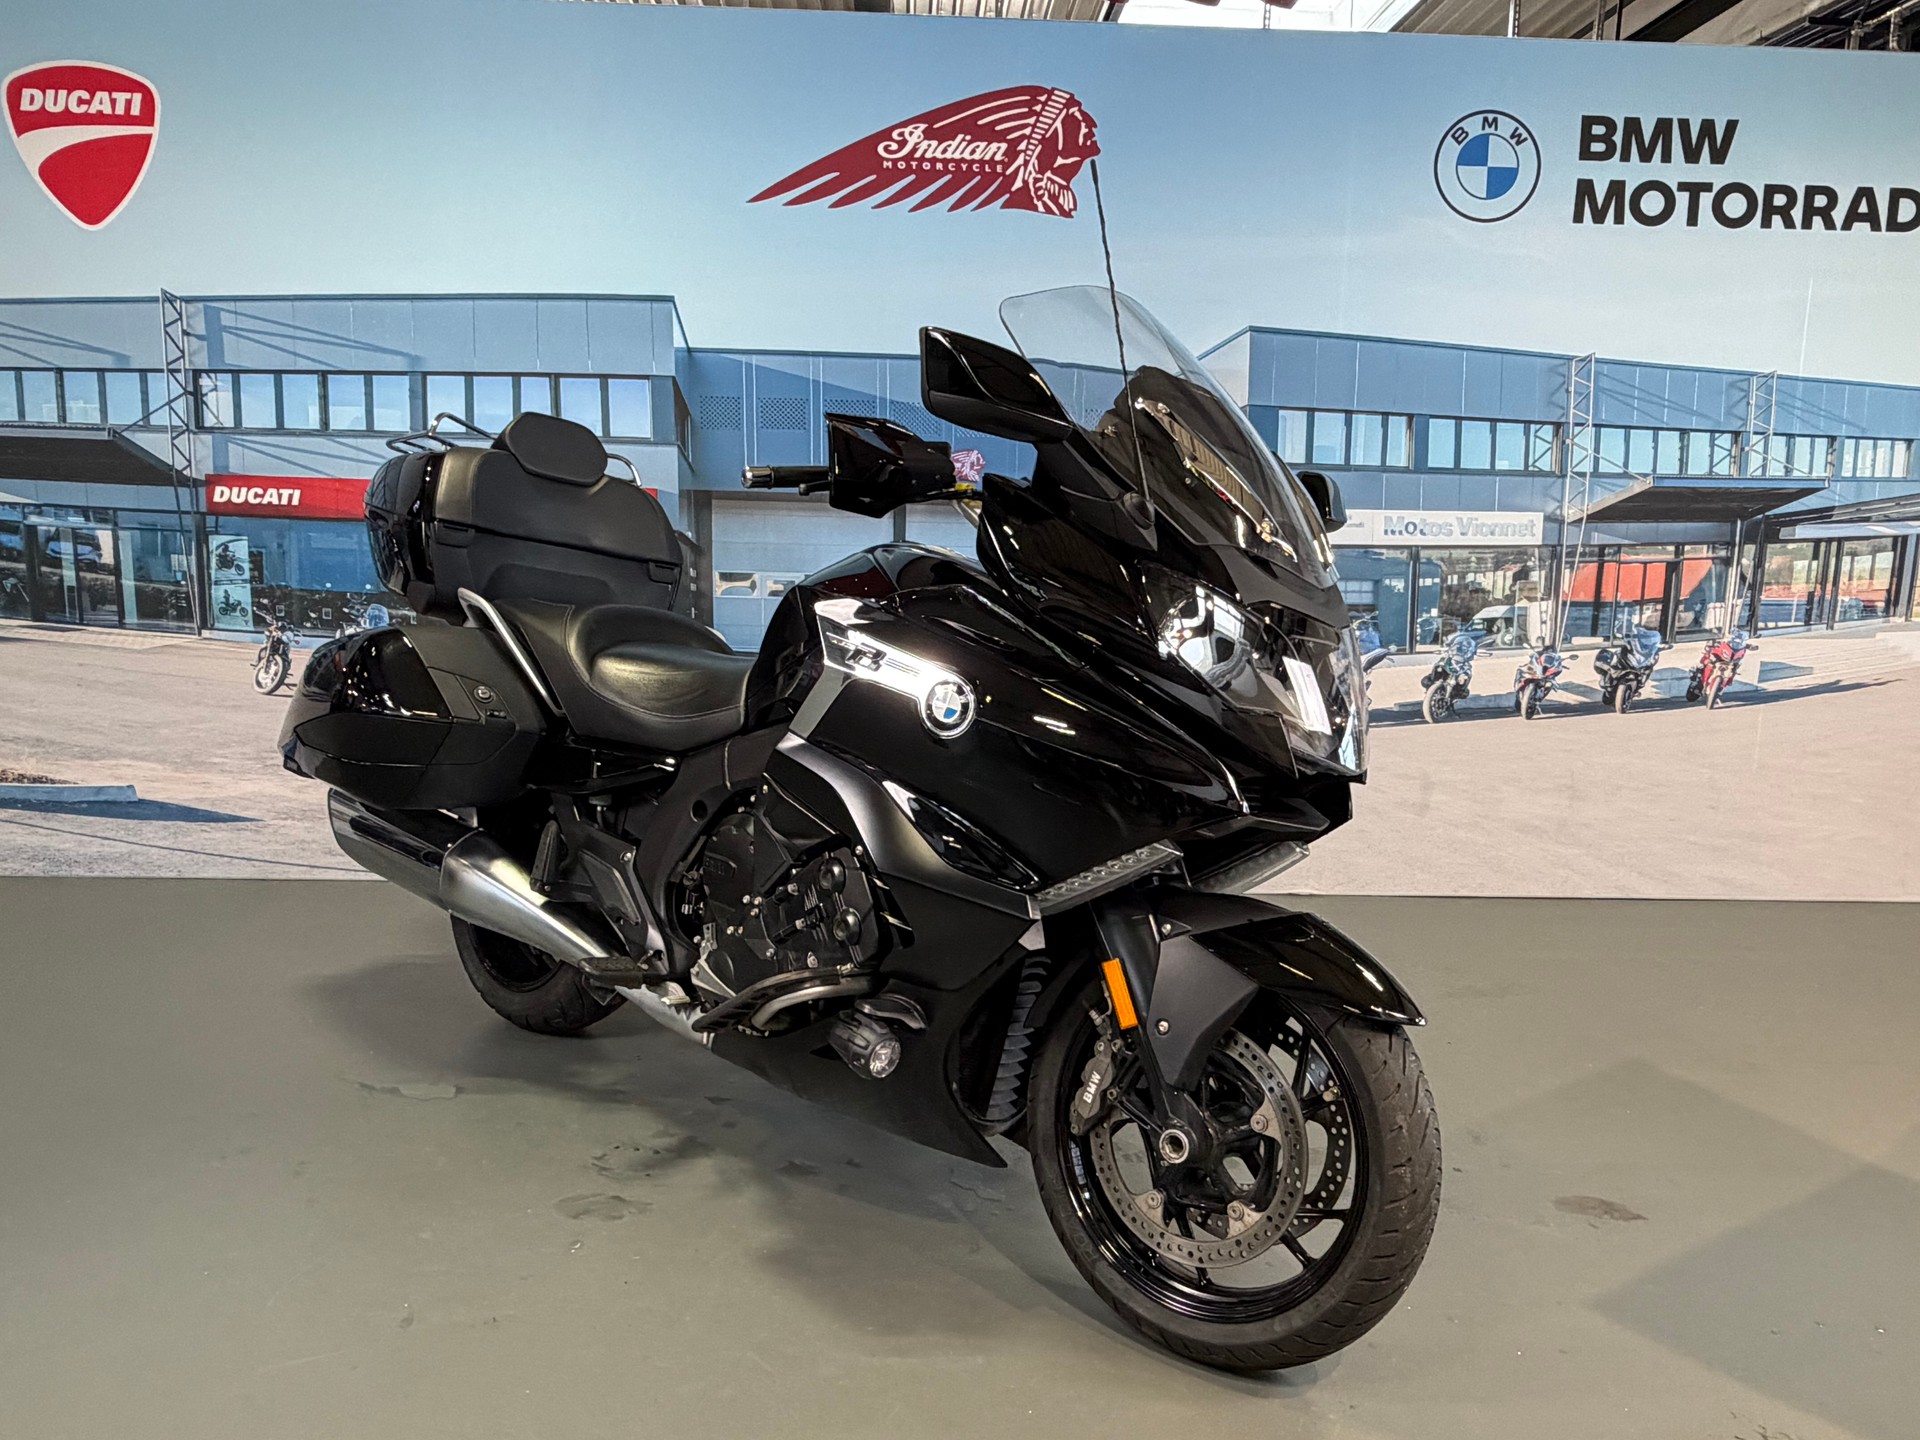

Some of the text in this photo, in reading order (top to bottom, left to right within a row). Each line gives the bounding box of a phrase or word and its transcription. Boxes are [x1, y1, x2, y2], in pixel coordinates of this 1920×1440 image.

[20, 88, 142, 116] DUCATI
[877, 123, 1008, 161] Indian
[1450, 115, 1529, 147] BMW
[1578, 114, 1740, 165] BMW
[883, 160, 1003, 173] MOTORCYCLE
[1572, 178, 1920, 232] MOTORRAD
[213, 485, 301, 506] DUCATI
[1383, 515, 1454, 537] Motos
[1082, 1070, 1102, 1104] BMW
